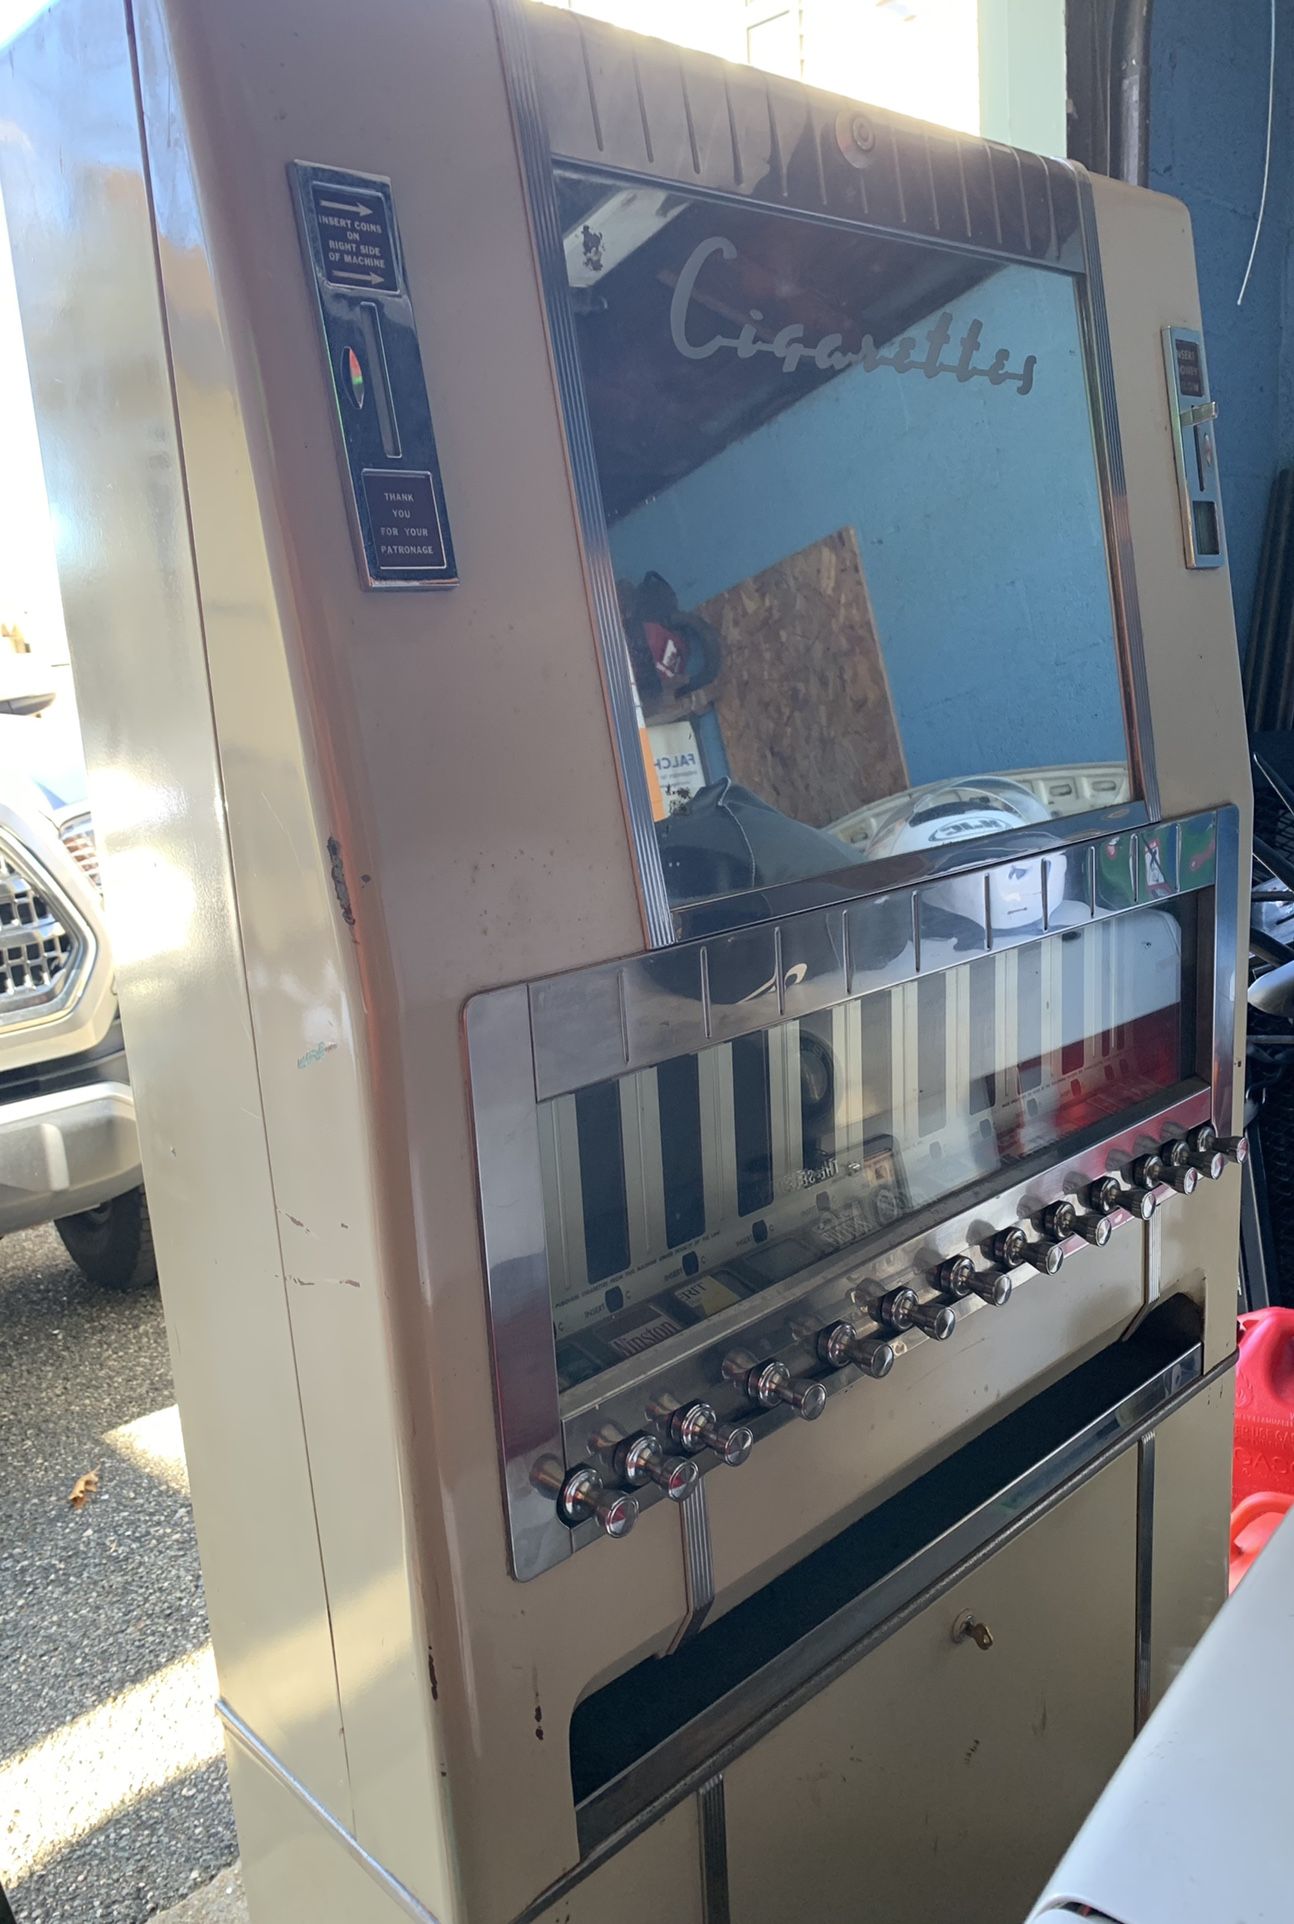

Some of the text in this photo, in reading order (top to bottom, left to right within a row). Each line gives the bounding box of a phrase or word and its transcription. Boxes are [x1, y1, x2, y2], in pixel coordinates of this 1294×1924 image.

[318, 215, 382, 234] INSERT COINS
[346, 231, 360, 241] ON
[328, 240, 381, 256] RIGHT SIDE
[328, 252, 385, 268] OF MACHINE
[670, 236, 1037, 396] Cigarettes
[384, 492, 414, 502] THANK
[392, 509, 411, 519] YOU
[380, 527, 429, 537] FOR YOUR
[380, 545, 434, 555] PATRONAGE
